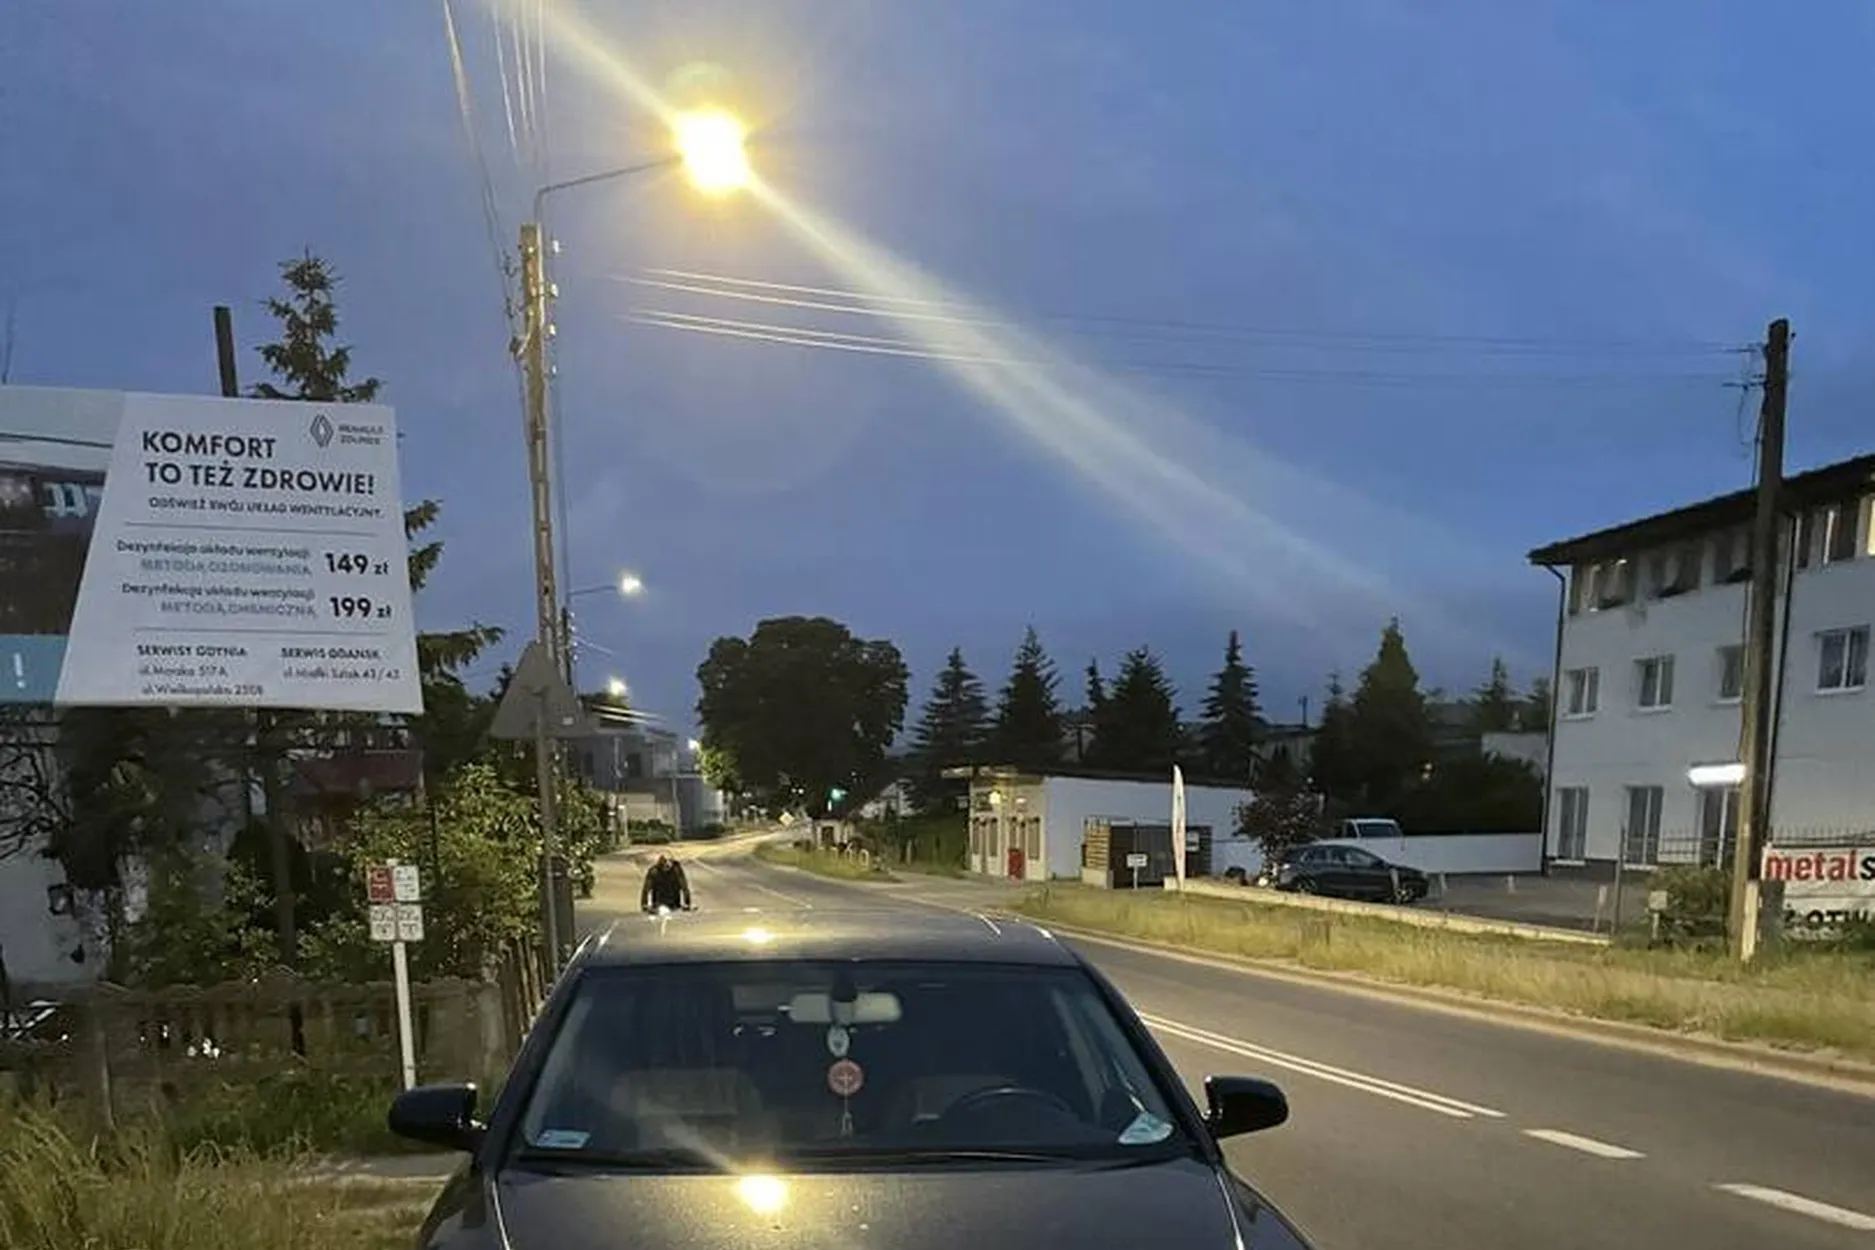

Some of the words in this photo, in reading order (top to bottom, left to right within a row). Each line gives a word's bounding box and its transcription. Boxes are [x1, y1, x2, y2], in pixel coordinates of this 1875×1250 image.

[143, 431, 276, 458] KOMFORT
[146, 463, 182, 485] TO
[190, 460, 234, 487] TEŻ
[243, 467, 375, 496] ZDROWIE!
[325, 553, 368, 575] 149
[374, 562, 389, 575] zł
[330, 597, 371, 618] 199
[377, 605, 391, 618] zł
